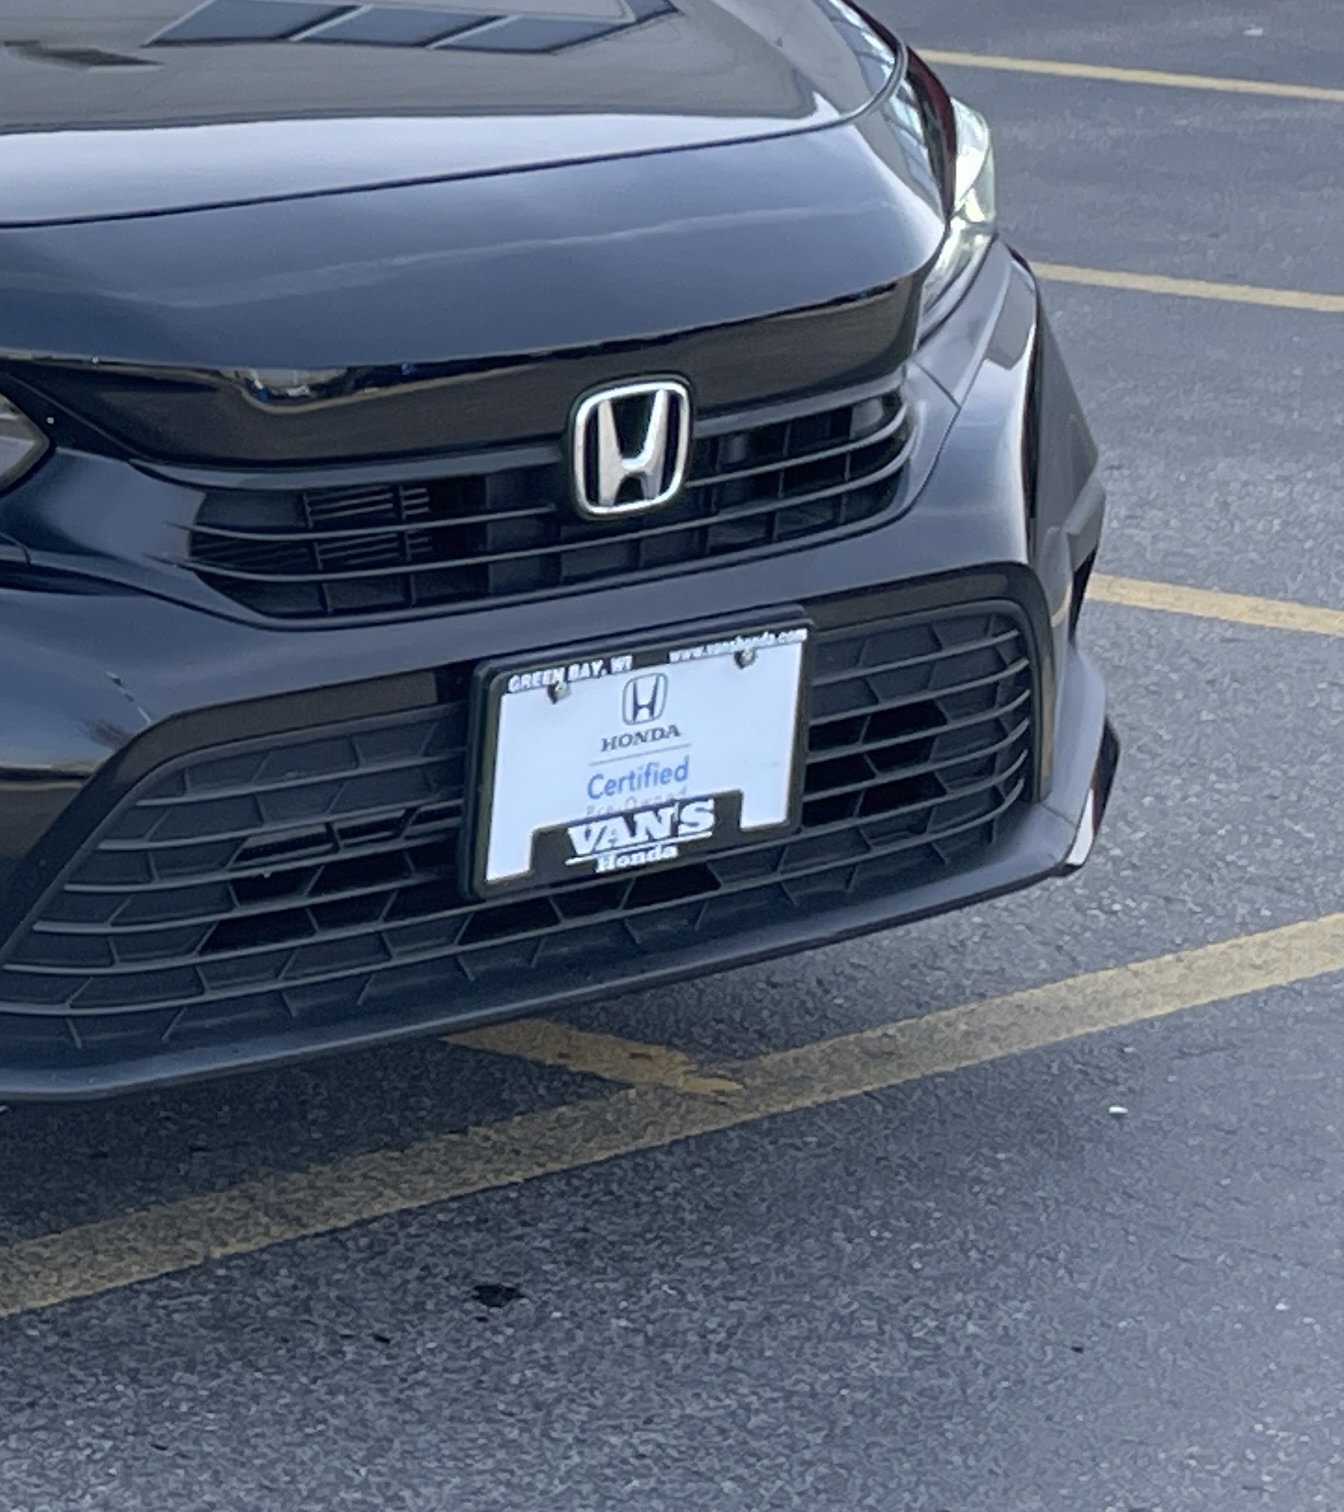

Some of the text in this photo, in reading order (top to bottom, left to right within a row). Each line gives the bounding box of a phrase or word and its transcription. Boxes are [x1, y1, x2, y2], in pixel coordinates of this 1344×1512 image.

[508, 667, 566, 692] GREEN
[601, 724, 682, 752] HONDA
[587, 755, 691, 800] Certified
[595, 842, 680, 874] Honda
